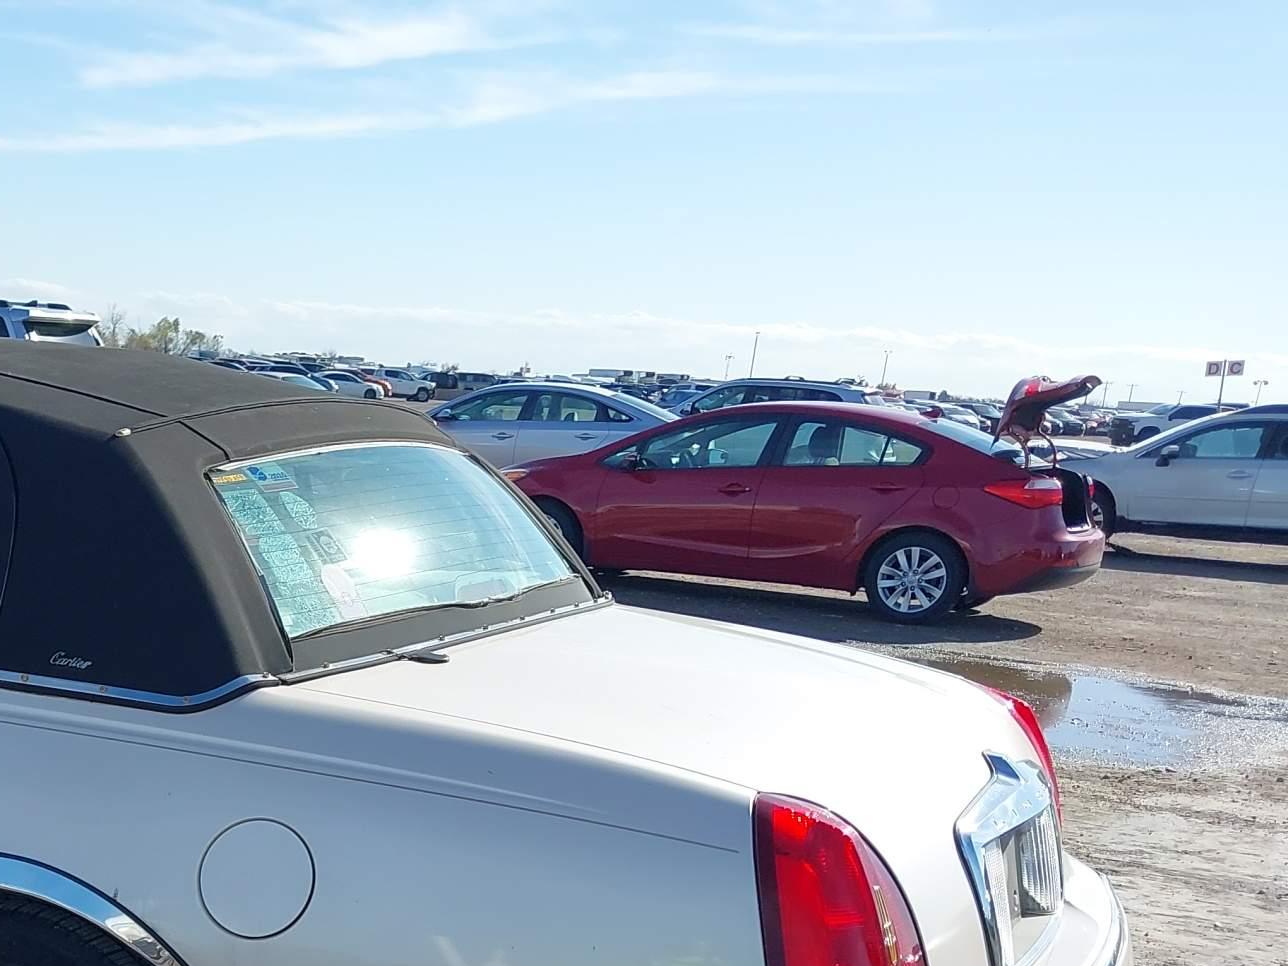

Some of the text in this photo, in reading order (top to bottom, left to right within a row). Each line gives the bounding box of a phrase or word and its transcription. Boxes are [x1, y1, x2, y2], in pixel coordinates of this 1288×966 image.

[1207, 362, 1220, 375] D
[1229, 362, 1242, 375] C
[49, 651, 93, 669] Cartier
